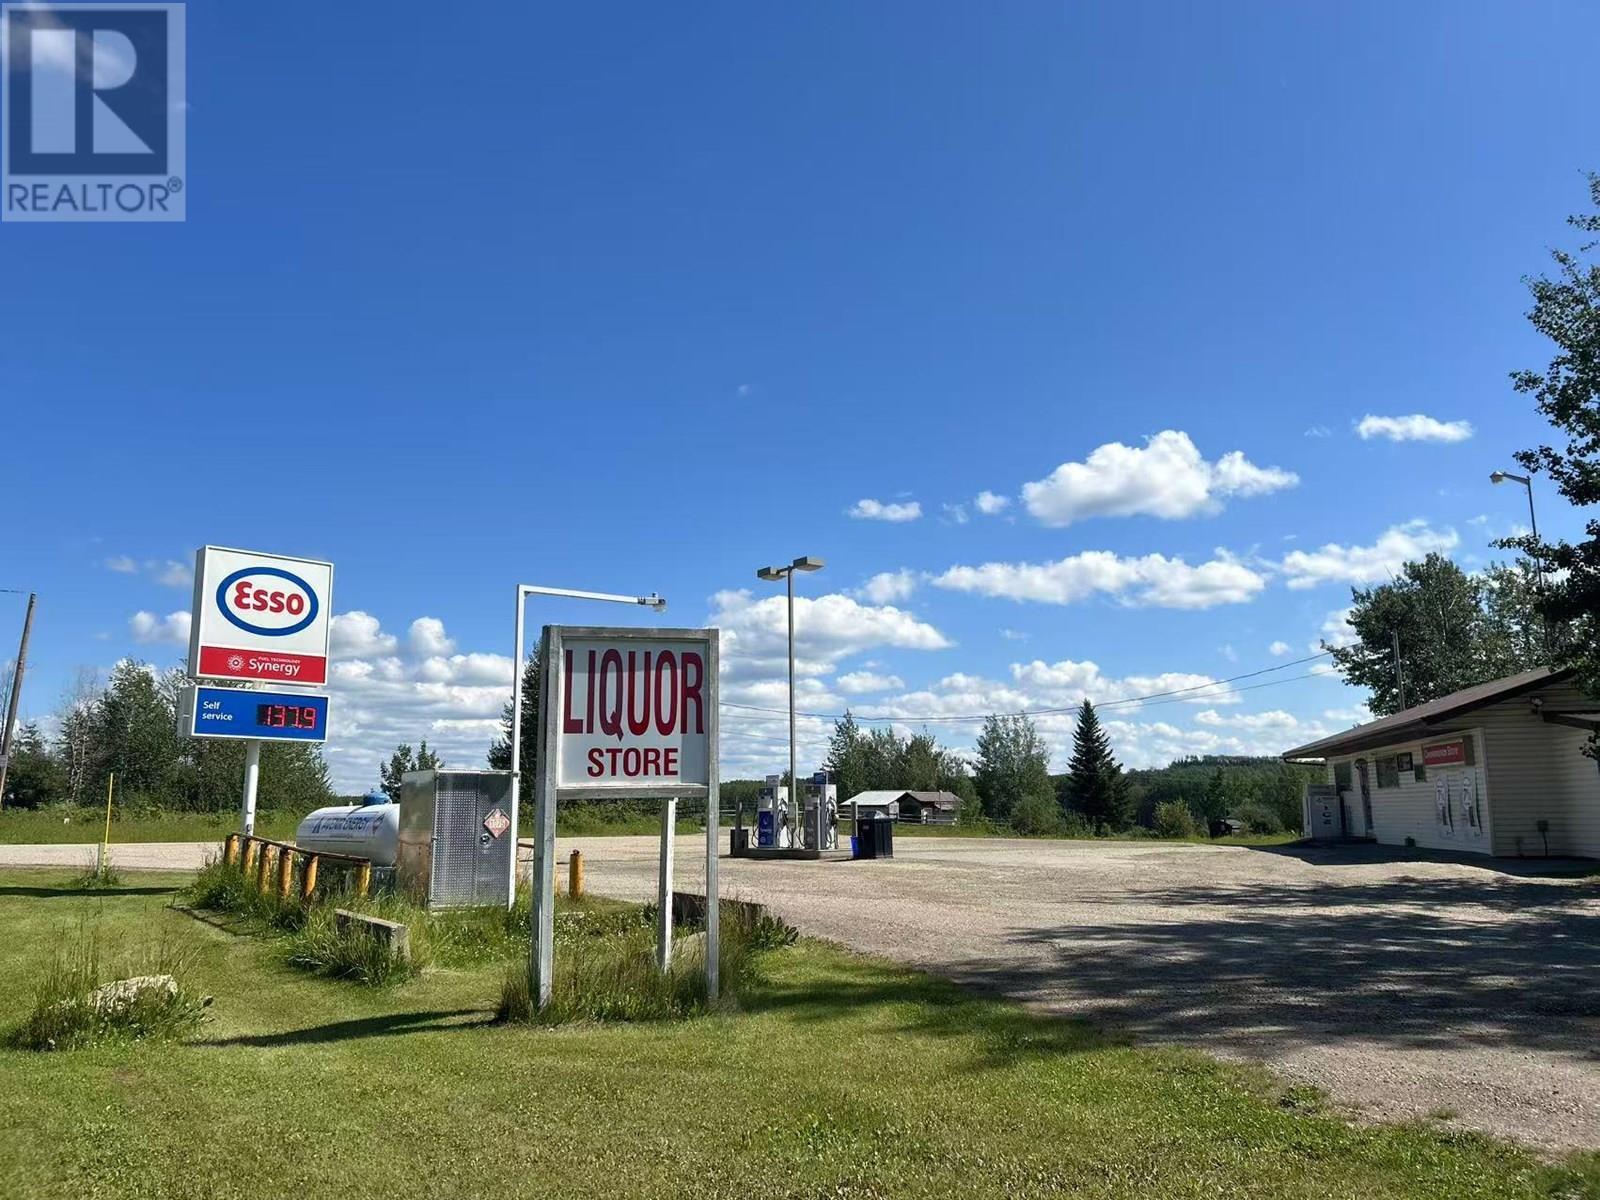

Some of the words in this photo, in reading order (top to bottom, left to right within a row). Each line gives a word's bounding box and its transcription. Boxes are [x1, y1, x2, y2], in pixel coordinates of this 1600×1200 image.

[234, 581, 305, 616] Esso
[248, 658, 300, 677] Synergy
[203, 700, 220, 710] Self
[563, 648, 704, 742] LIQUOR
[202, 712, 233, 722] service
[587, 747, 678, 777] STORE
